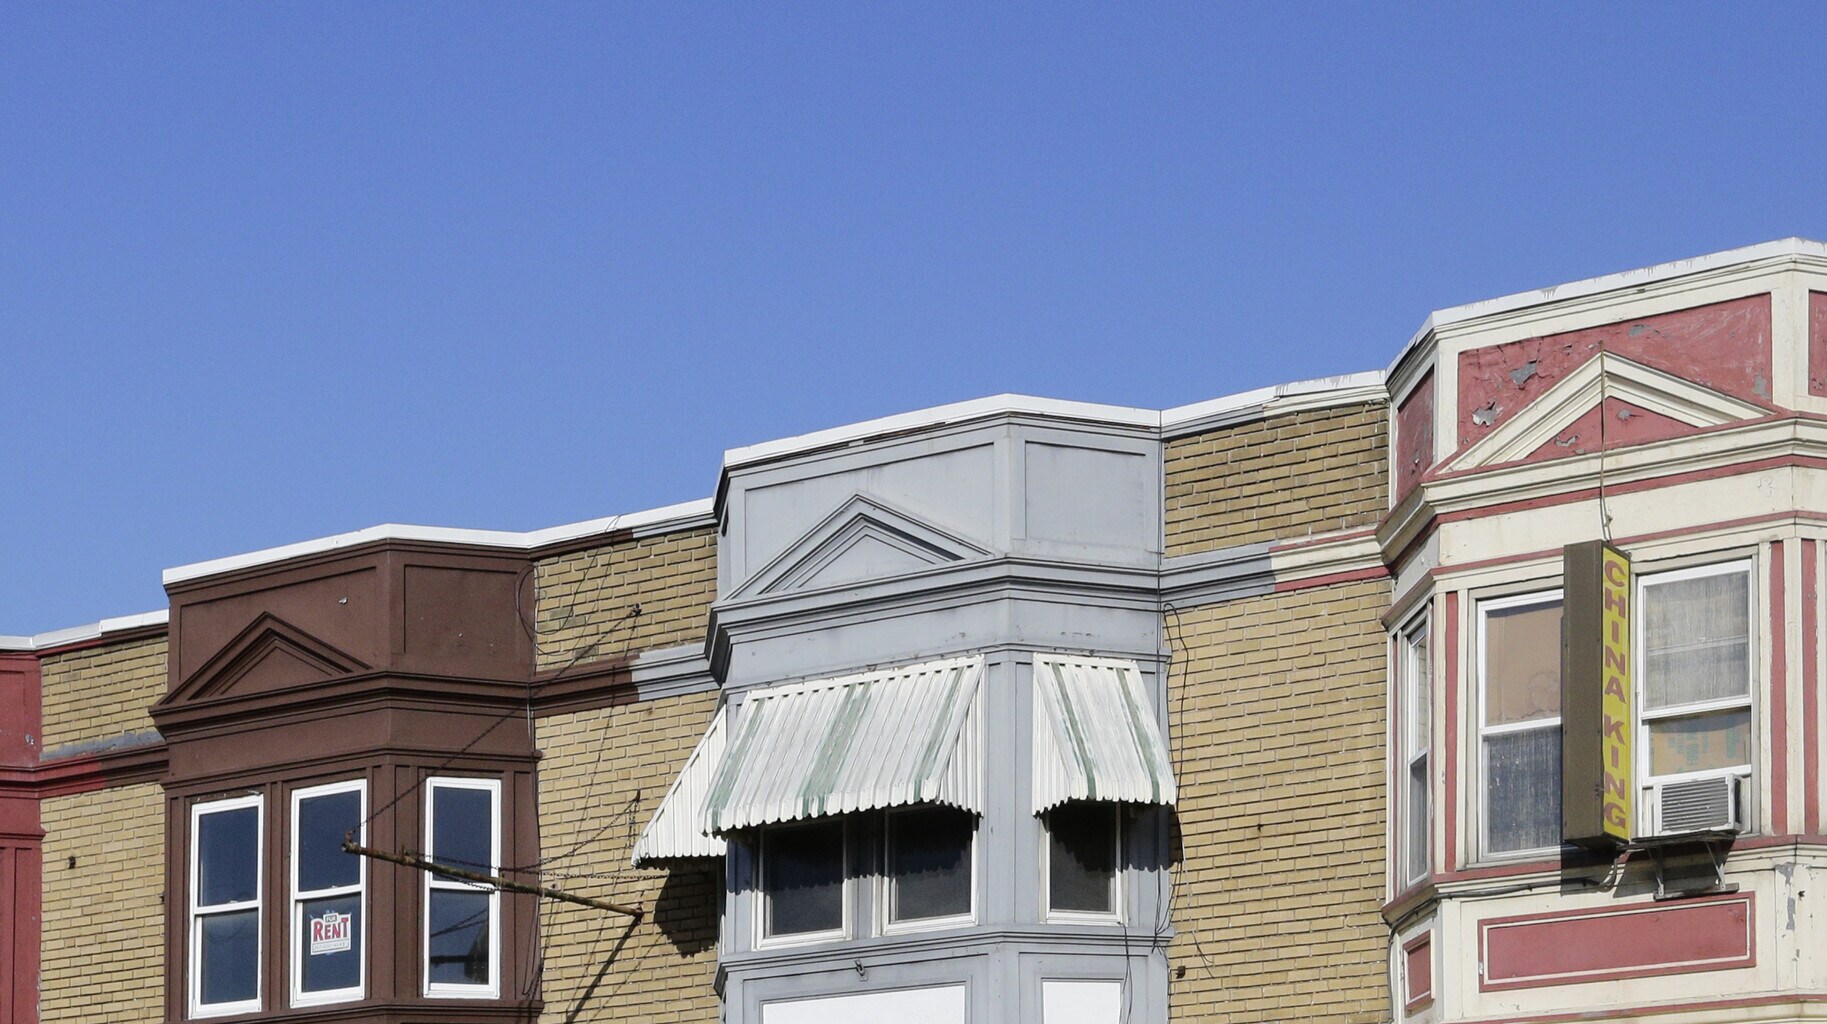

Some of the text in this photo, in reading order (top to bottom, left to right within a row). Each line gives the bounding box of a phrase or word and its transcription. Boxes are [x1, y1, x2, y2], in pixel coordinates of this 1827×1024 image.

[1604, 560, 1626, 829] CHINA KING
[313, 917, 349, 942] RENT
